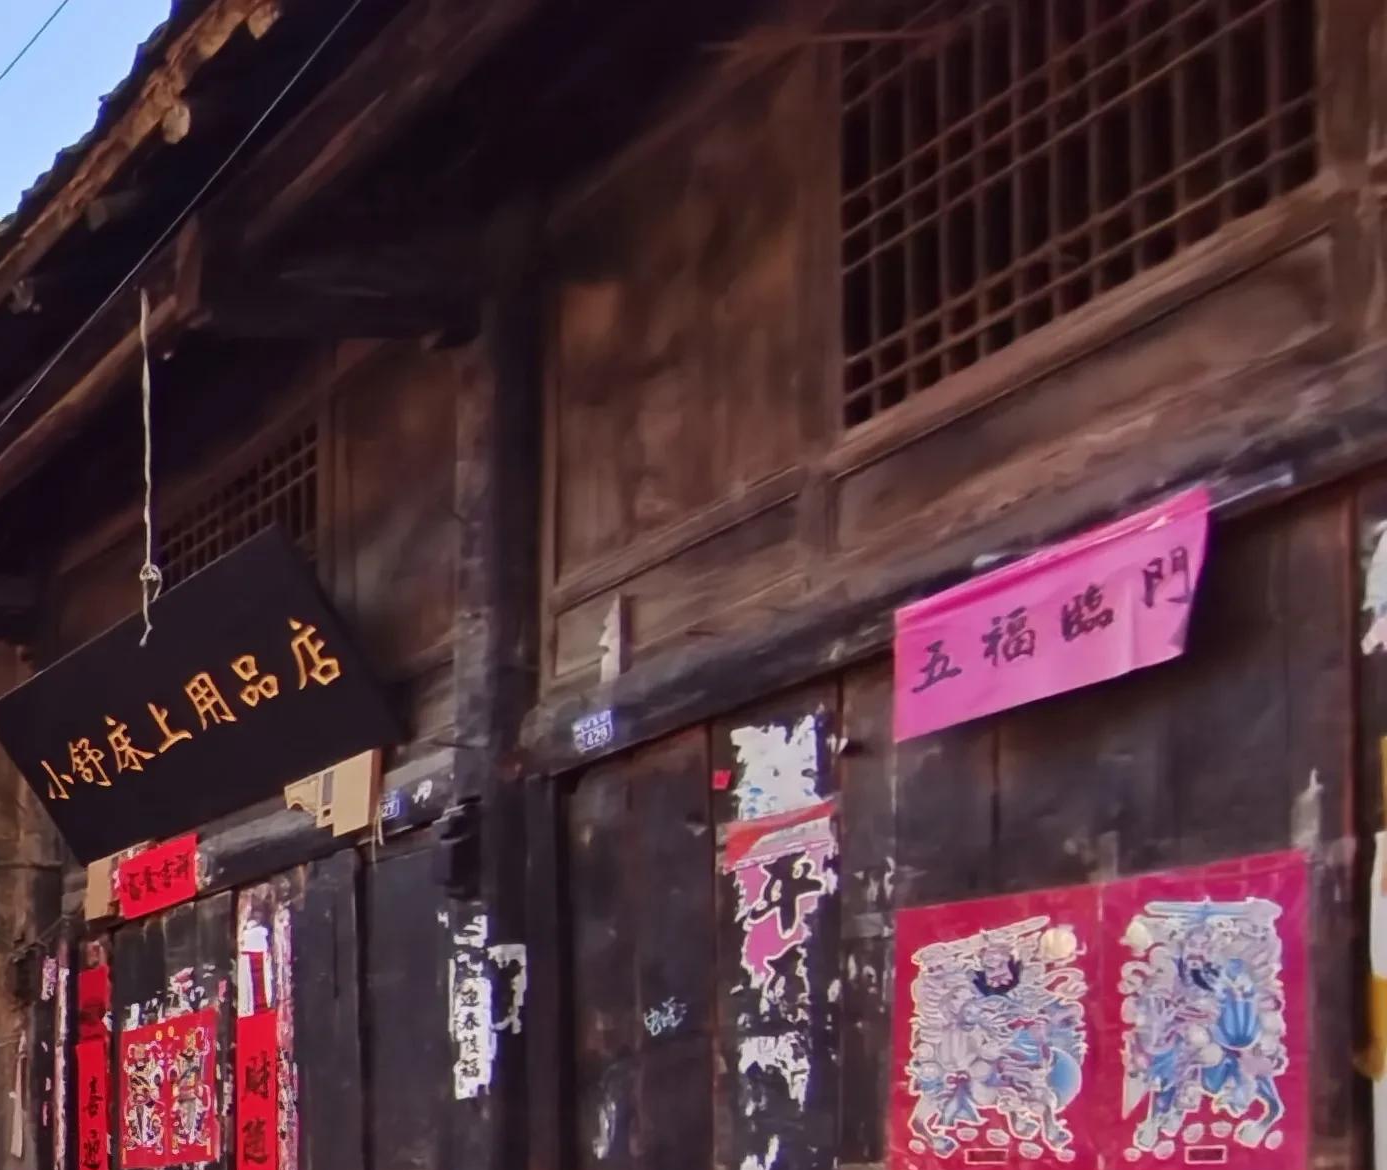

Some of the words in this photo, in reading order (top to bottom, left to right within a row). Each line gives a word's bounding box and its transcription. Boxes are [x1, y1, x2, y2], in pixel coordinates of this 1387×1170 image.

[912, 546, 1190, 693] 五福臨門
[40, 616, 341, 800] 小舒床上用品店
